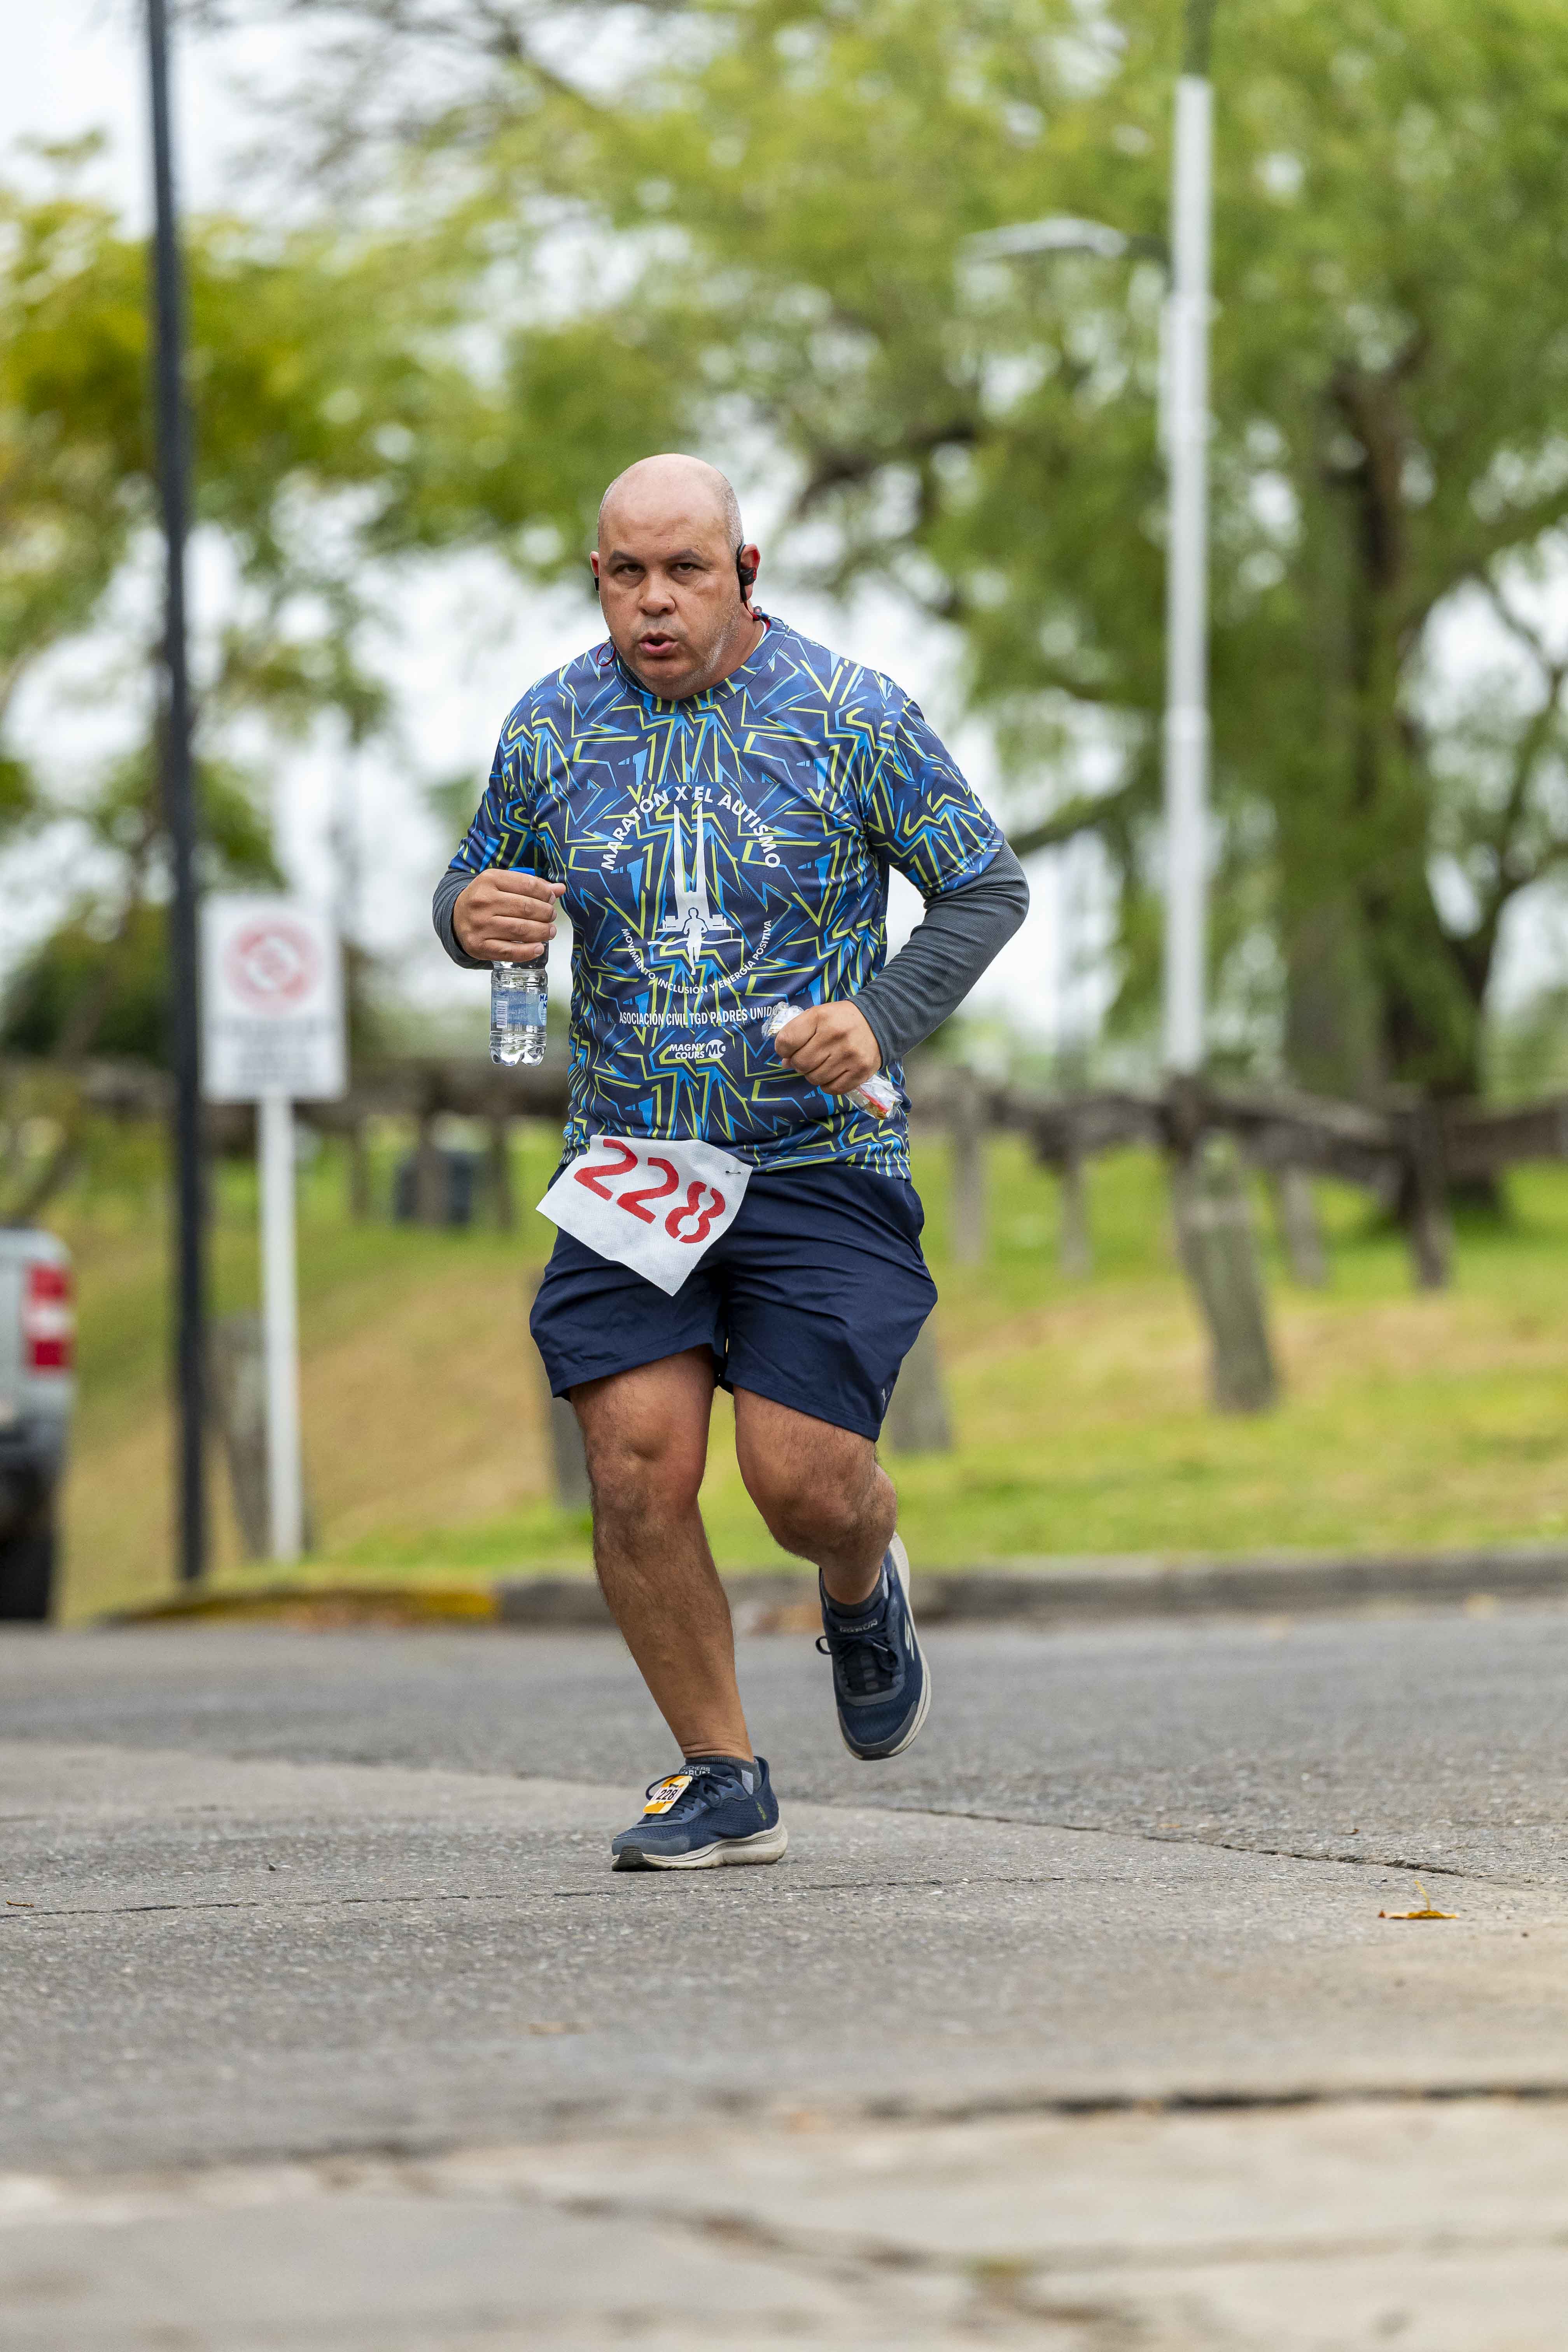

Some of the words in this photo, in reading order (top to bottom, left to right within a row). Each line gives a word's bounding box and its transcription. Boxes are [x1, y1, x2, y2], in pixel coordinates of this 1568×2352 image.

[601, 789, 670, 871] MARATÓN
[674, 786, 688, 801] X
[694, 786, 713, 803] EL
[717, 794, 781, 868] AUTISMO
[657, 978, 708, 994] INCLUSIÓN
[709, 983, 716, 991] Y
[718, 960, 756, 989] ENERGÍA
[752, 920, 772, 961] POSITIVA
[619, 1010, 664, 1026] ASOCIACIÓN
[665, 1013, 688, 1026] CIVIL
[689, 1012, 708, 1025] TGD
[710, 1008, 748, 1024] PADRES
[669, 1043, 705, 1052] MAGNY
[675, 1051, 705, 1059] COURS
[573, 1138, 726, 1244] 228
[656, 1789, 678, 1800] 228
